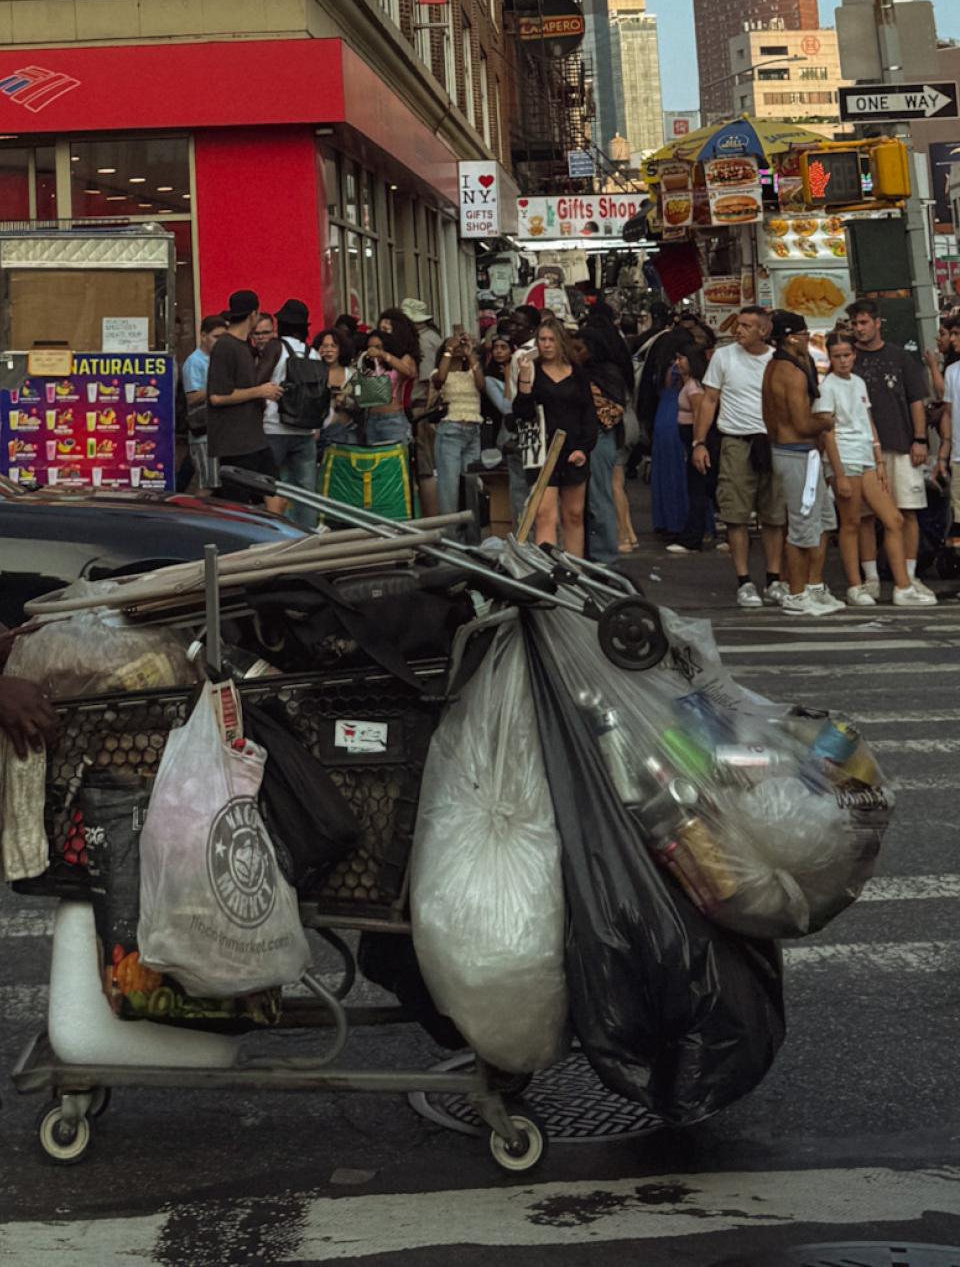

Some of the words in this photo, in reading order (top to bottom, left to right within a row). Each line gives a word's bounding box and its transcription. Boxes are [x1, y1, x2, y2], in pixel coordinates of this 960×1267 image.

[856, 95, 888, 111] ONE
[904, 93, 940, 109] WAY
[461, 174, 471, 188] I
[466, 209, 493, 219] GIFTS
[557, 197, 593, 219] Gifts
[599, 197, 637, 219] Shop
[466, 221, 493, 232] SHOP
